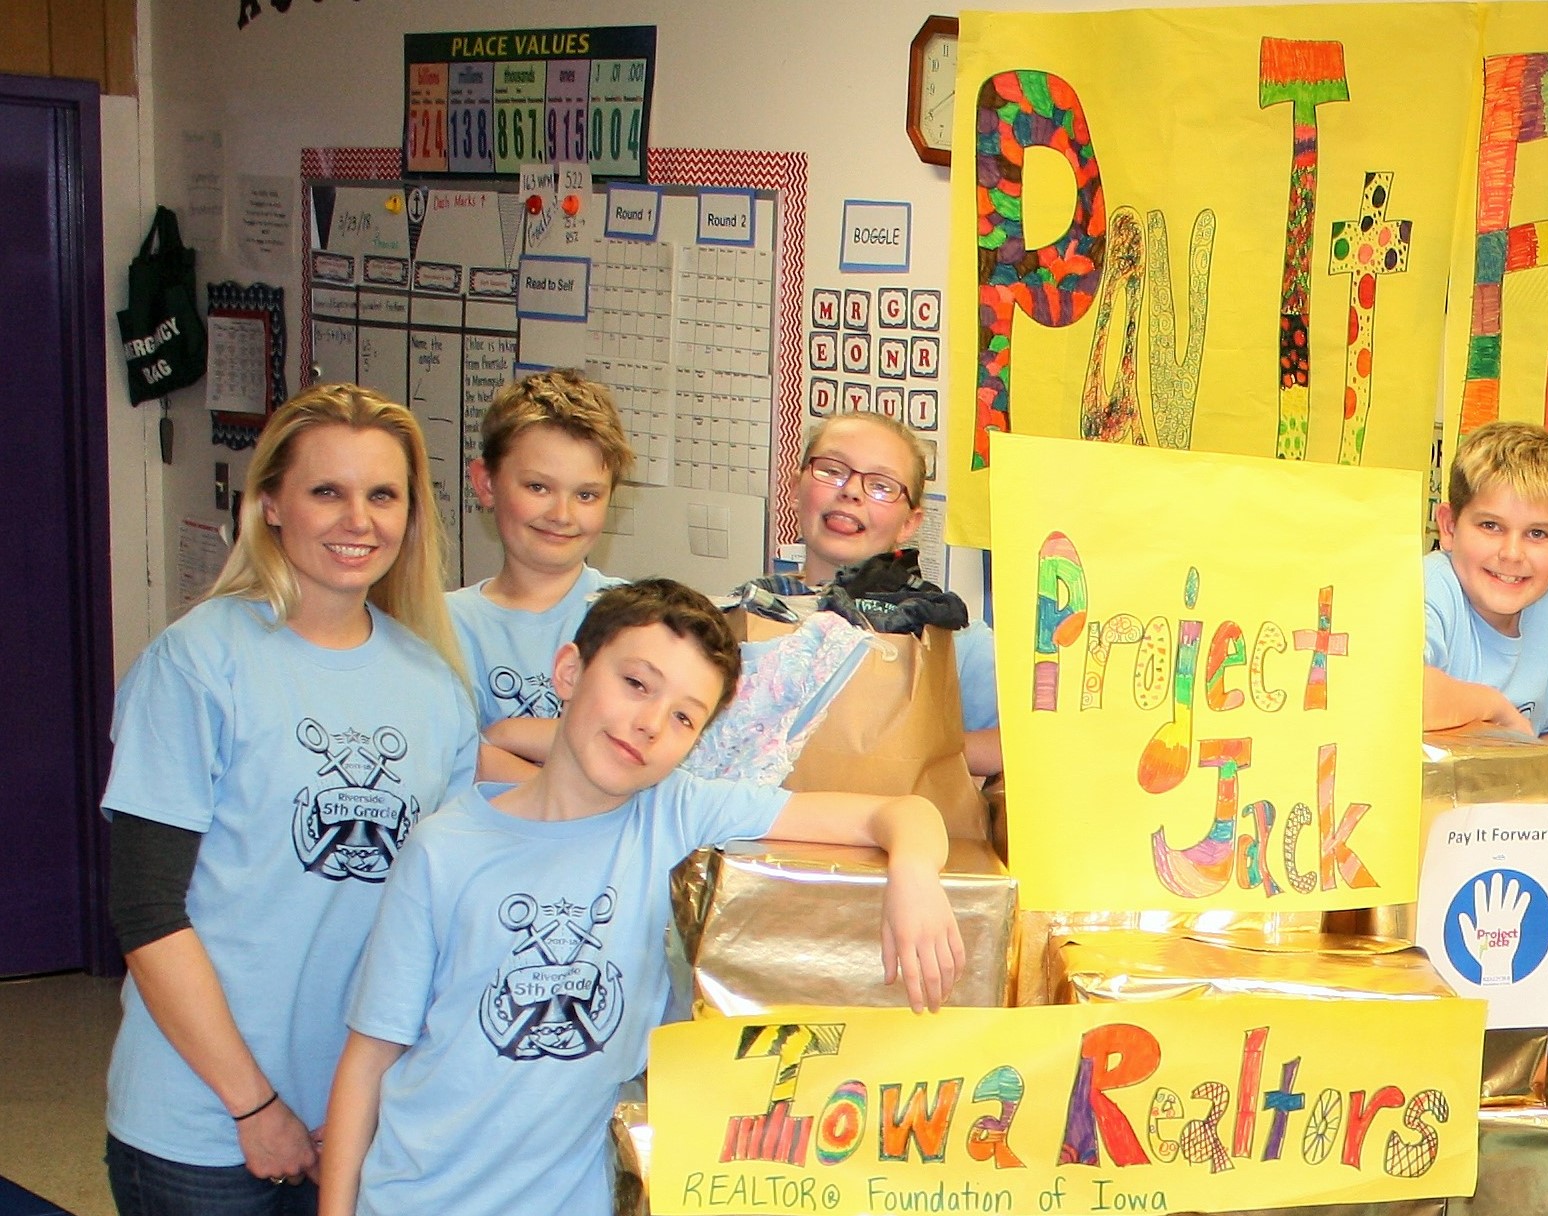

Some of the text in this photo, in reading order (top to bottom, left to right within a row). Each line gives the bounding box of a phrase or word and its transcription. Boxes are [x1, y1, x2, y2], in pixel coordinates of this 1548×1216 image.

[452, 33, 590, 57] PLACE VALUES
[564, 170, 583, 190] 522
[615, 206, 652, 221] Round 1
[707, 213, 747, 228] Round 2
[853, 227, 900, 246] BOGGLE
[525, 277, 575, 291] Read to Self
[819, 300, 931, 320] M R G C
[816, 343, 931, 368] E O N R
[817, 390, 829, 408] D
[883, 399, 896, 416] U
[1032, 531, 1349, 794] Project
[338, 791, 385, 804] Riverside
[322, 803, 398, 820] 5th Grade
[1151, 738, 1381, 898] Jack
[1447, 828, 1472, 846] Pay
[1476, 827, 1488, 842] It
[1477, 928, 1518, 943] Project
[513, 978, 592, 997] 5th Gade
[720, 1022, 1450, 1178] Iowa Realtors
[868, 1176, 1013, 1213] Foundation
[1039, 1176, 1067, 1211] of
[1091, 1179, 1167, 1212] Iowa
